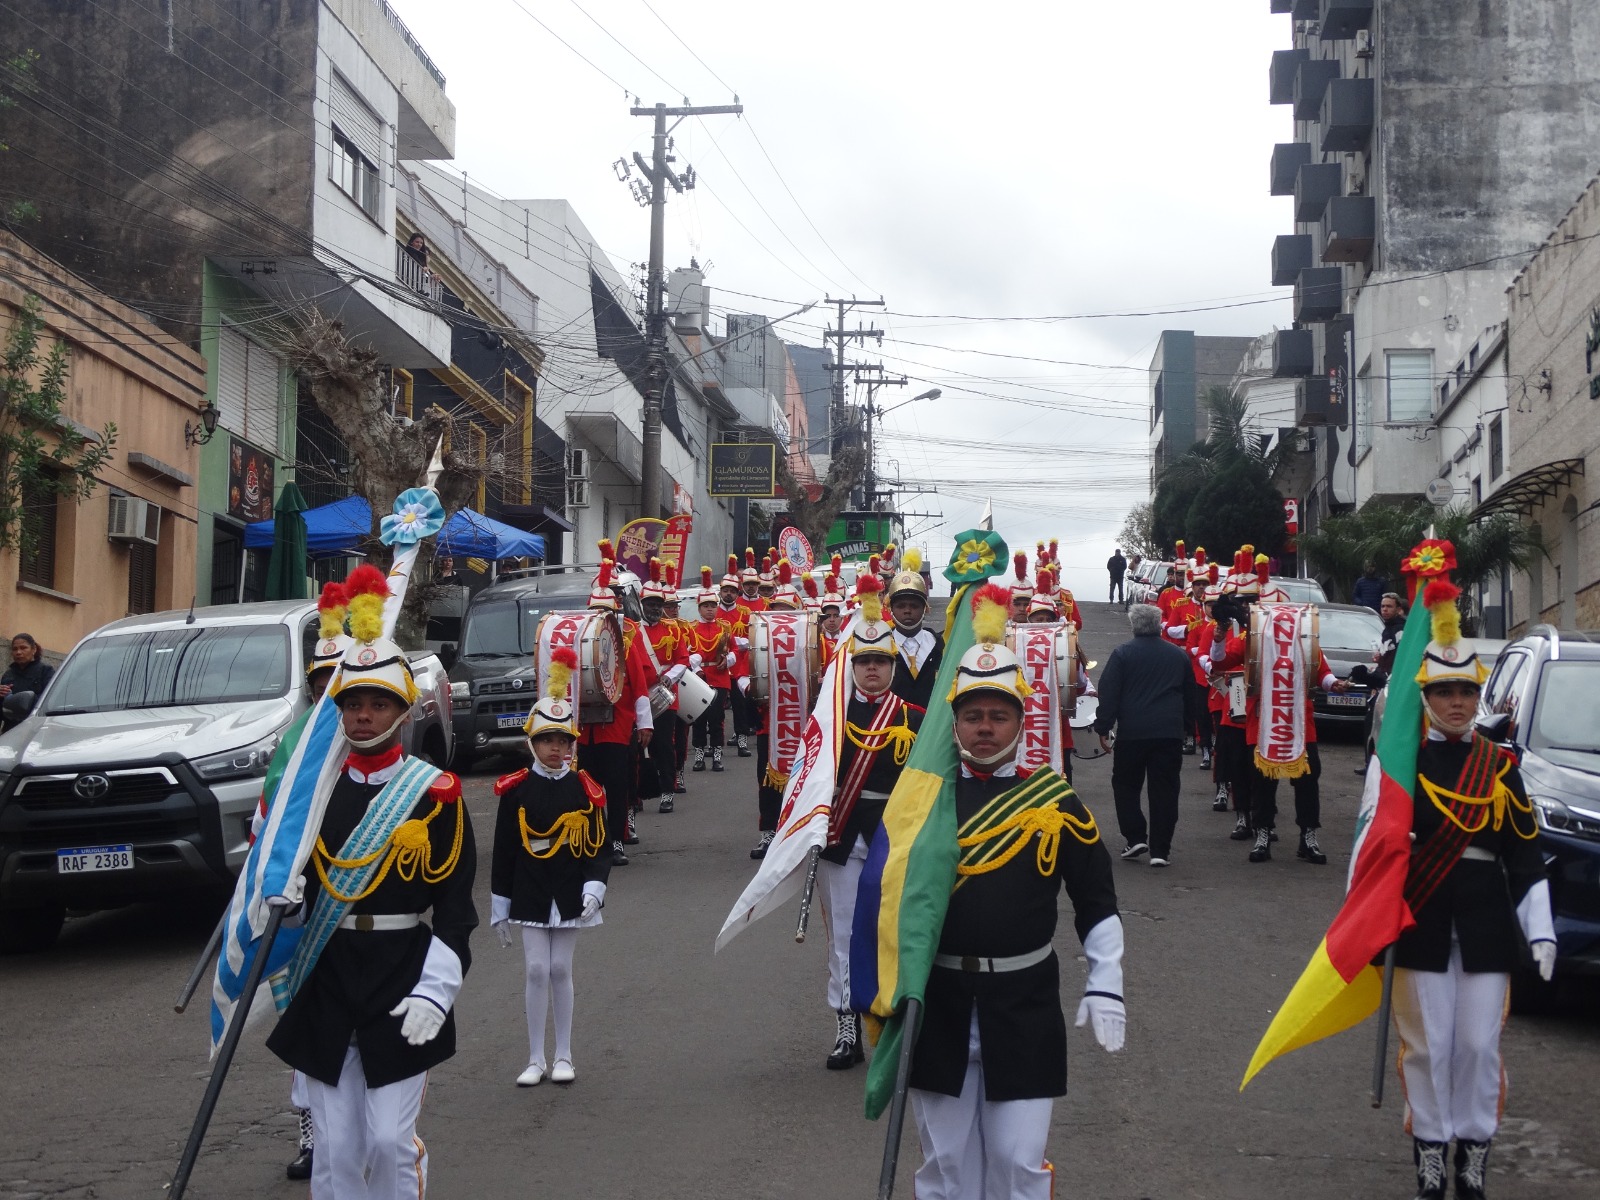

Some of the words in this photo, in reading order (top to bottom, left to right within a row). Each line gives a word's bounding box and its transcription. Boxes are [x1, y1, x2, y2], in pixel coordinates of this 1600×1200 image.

[714, 466, 769, 475] GLAMUROSA
[840, 541, 870, 557] MANAS
[771, 614, 801, 774] SANTANENSE
[1024, 628, 1054, 771] SANTANENS
[1267, 605, 1298, 760] SANTANENSE
[62, 855, 88, 871] RAF
[95, 853, 129, 869] 2388
